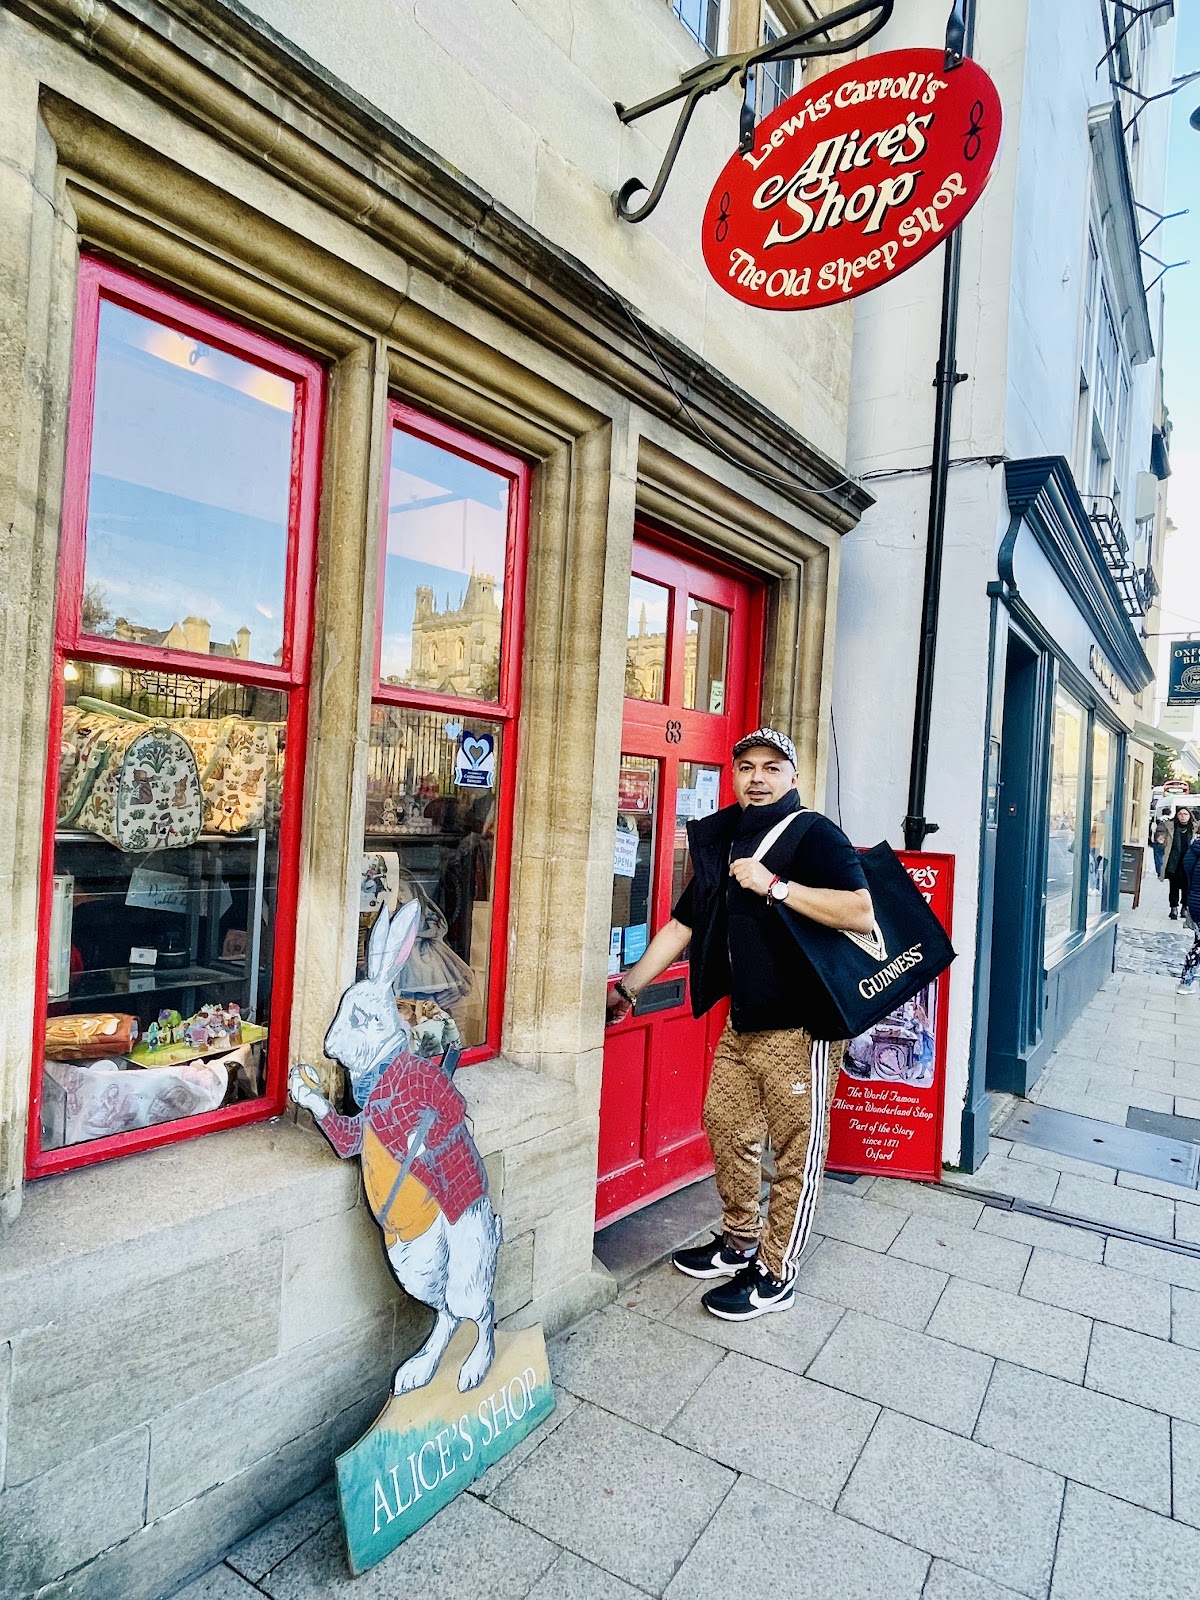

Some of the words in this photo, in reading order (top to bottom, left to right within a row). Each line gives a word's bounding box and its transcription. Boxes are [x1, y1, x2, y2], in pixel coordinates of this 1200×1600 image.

[743, 90, 834, 171] Lewis
[834, 71, 948, 108] Carroll's
[752, 111, 933, 210] Alice's
[763, 170, 924, 249] Shop
[729, 247, 767, 290] The
[765, 266, 812, 297] Old
[817, 240, 899, 293] Sheep
[898, 171, 968, 247] Shop
[1174, 648, 1200, 658] OXF
[858, 946, 924, 1000] GUINNESS
[832, 1098, 854, 1111] Alice
[855, 1103, 864, 1112] in
[865, 1101, 913, 1117] Wonderland
[912, 1106, 934, 1121] Shop
[847, 1086, 863, 1098] The
[864, 1087, 889, 1101] World
[889, 1090, 920, 1103] Famous
[849, 1118, 869, 1131] Part
[868, 1121, 879, 1135] of
[878, 1122, 891, 1134] the
[892, 1123, 914, 1140] Story
[862, 1136, 882, 1146] since
[883, 1138, 900, 1148] 1871
[865, 1147, 894, 1162] Oxford
[372, 1414, 474, 1535] ALICE'S
[478, 1366, 537, 1446] SHOP
